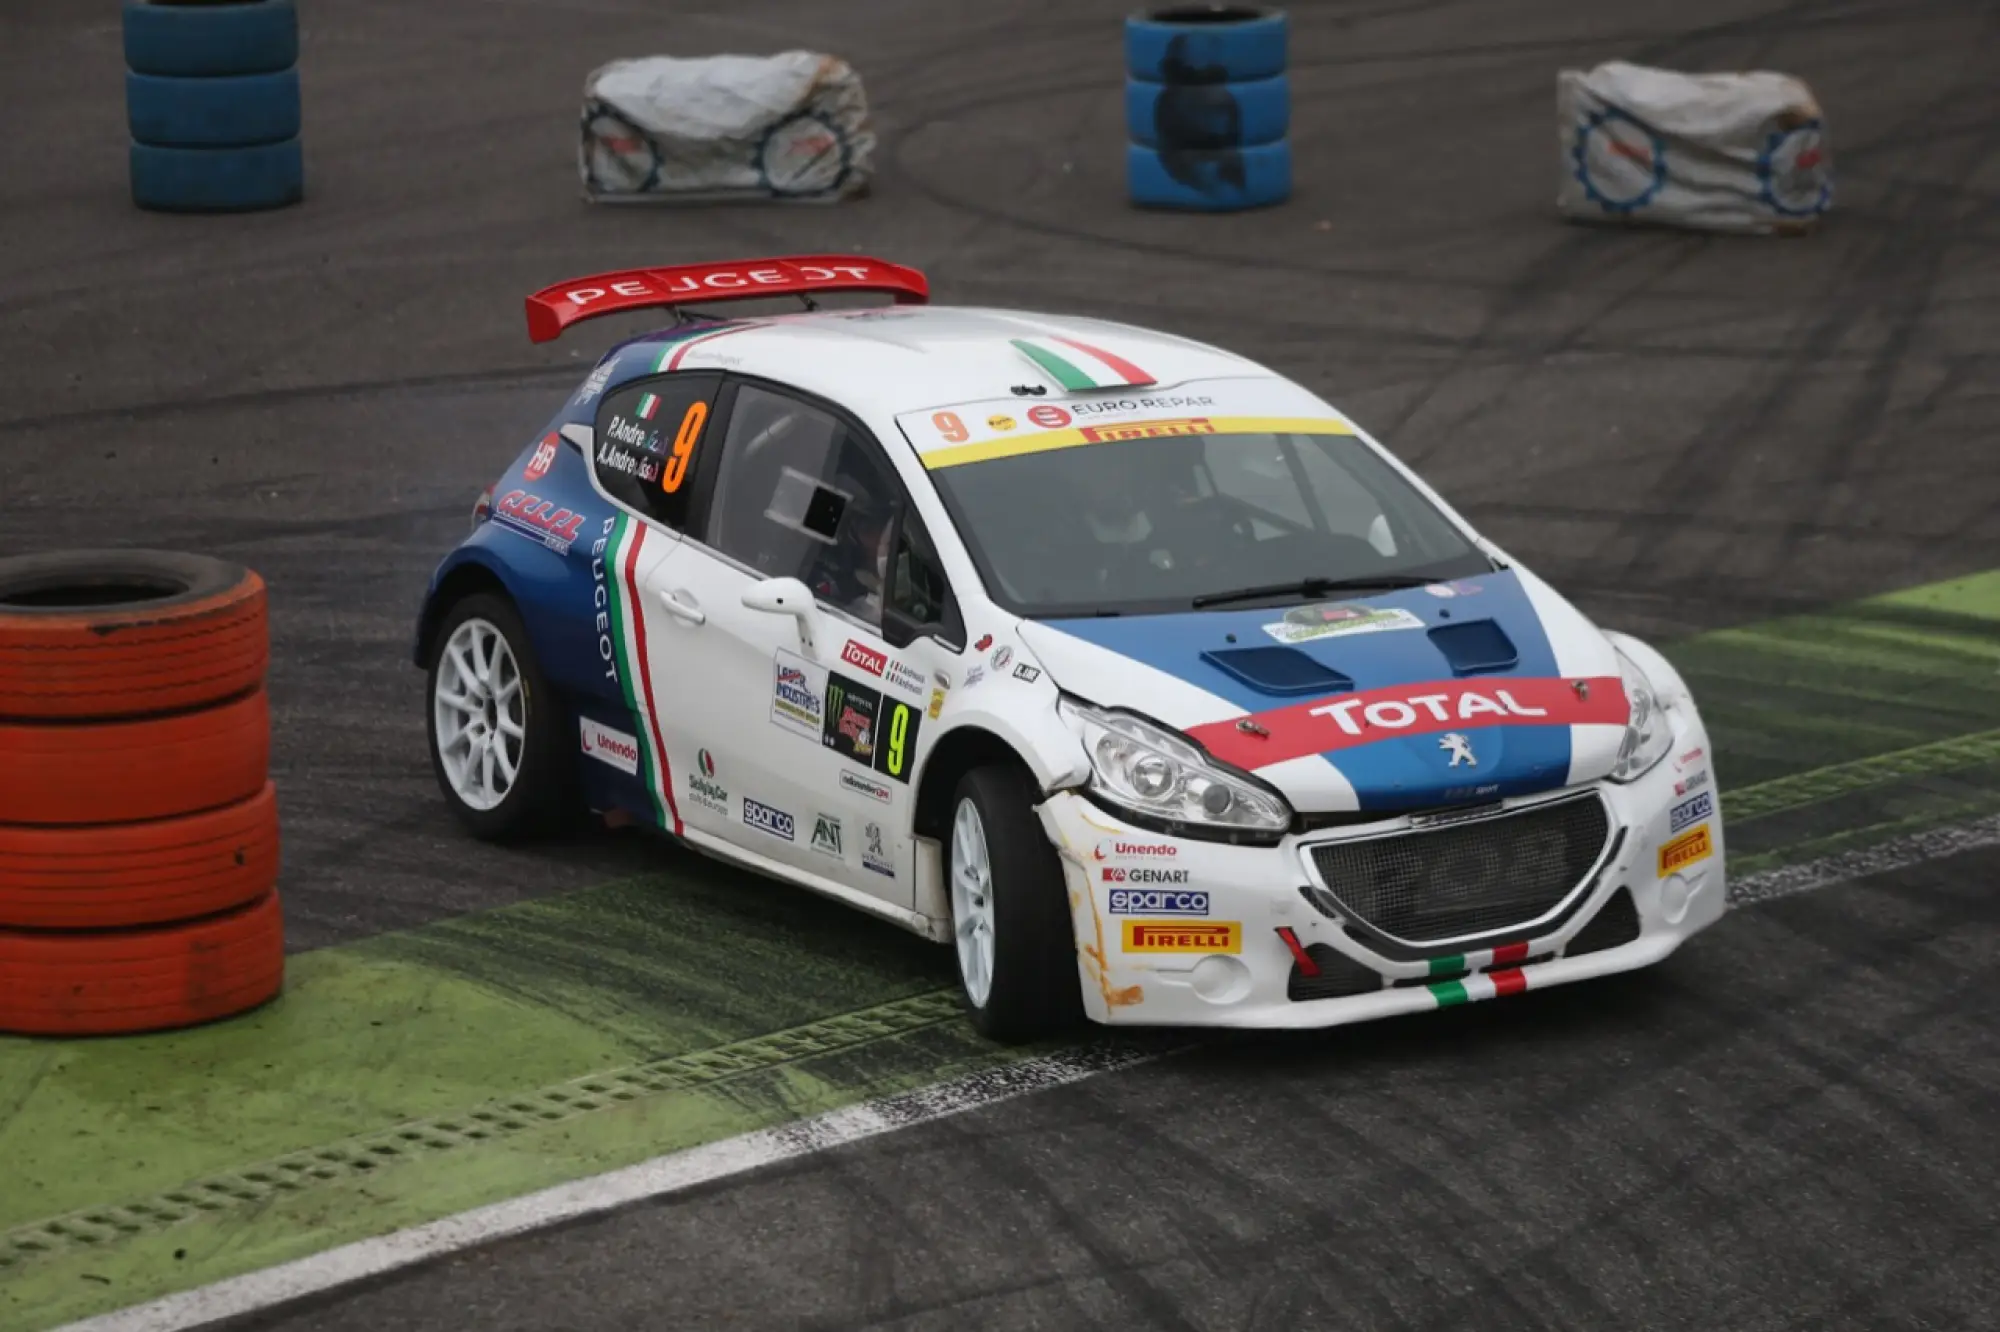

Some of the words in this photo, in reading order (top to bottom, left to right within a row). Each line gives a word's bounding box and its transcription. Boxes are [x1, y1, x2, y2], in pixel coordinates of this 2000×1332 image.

[1072, 400, 1137, 415] EURO
[1140, 396, 1214, 409] REPAR
[932, 411, 969, 442] 9
[1080, 418, 1215, 443] PIRELLI
[662, 401, 708, 493] 9
[591, 516, 618, 684] PEUGEOT
[845, 642, 883, 674] TOTAL
[1309, 690, 1548, 735] TOTAL
[597, 732, 637, 761] Unendo
[887, 703, 909, 776] 9
[744, 800, 793, 834] sparco
[811, 818, 841, 854] ANT
[1115, 842, 1177, 856] Unendo
[1129, 868, 1190, 884] GENART
[1111, 891, 1207, 913] sparco
[1133, 925, 1231, 947] PIRELLI
